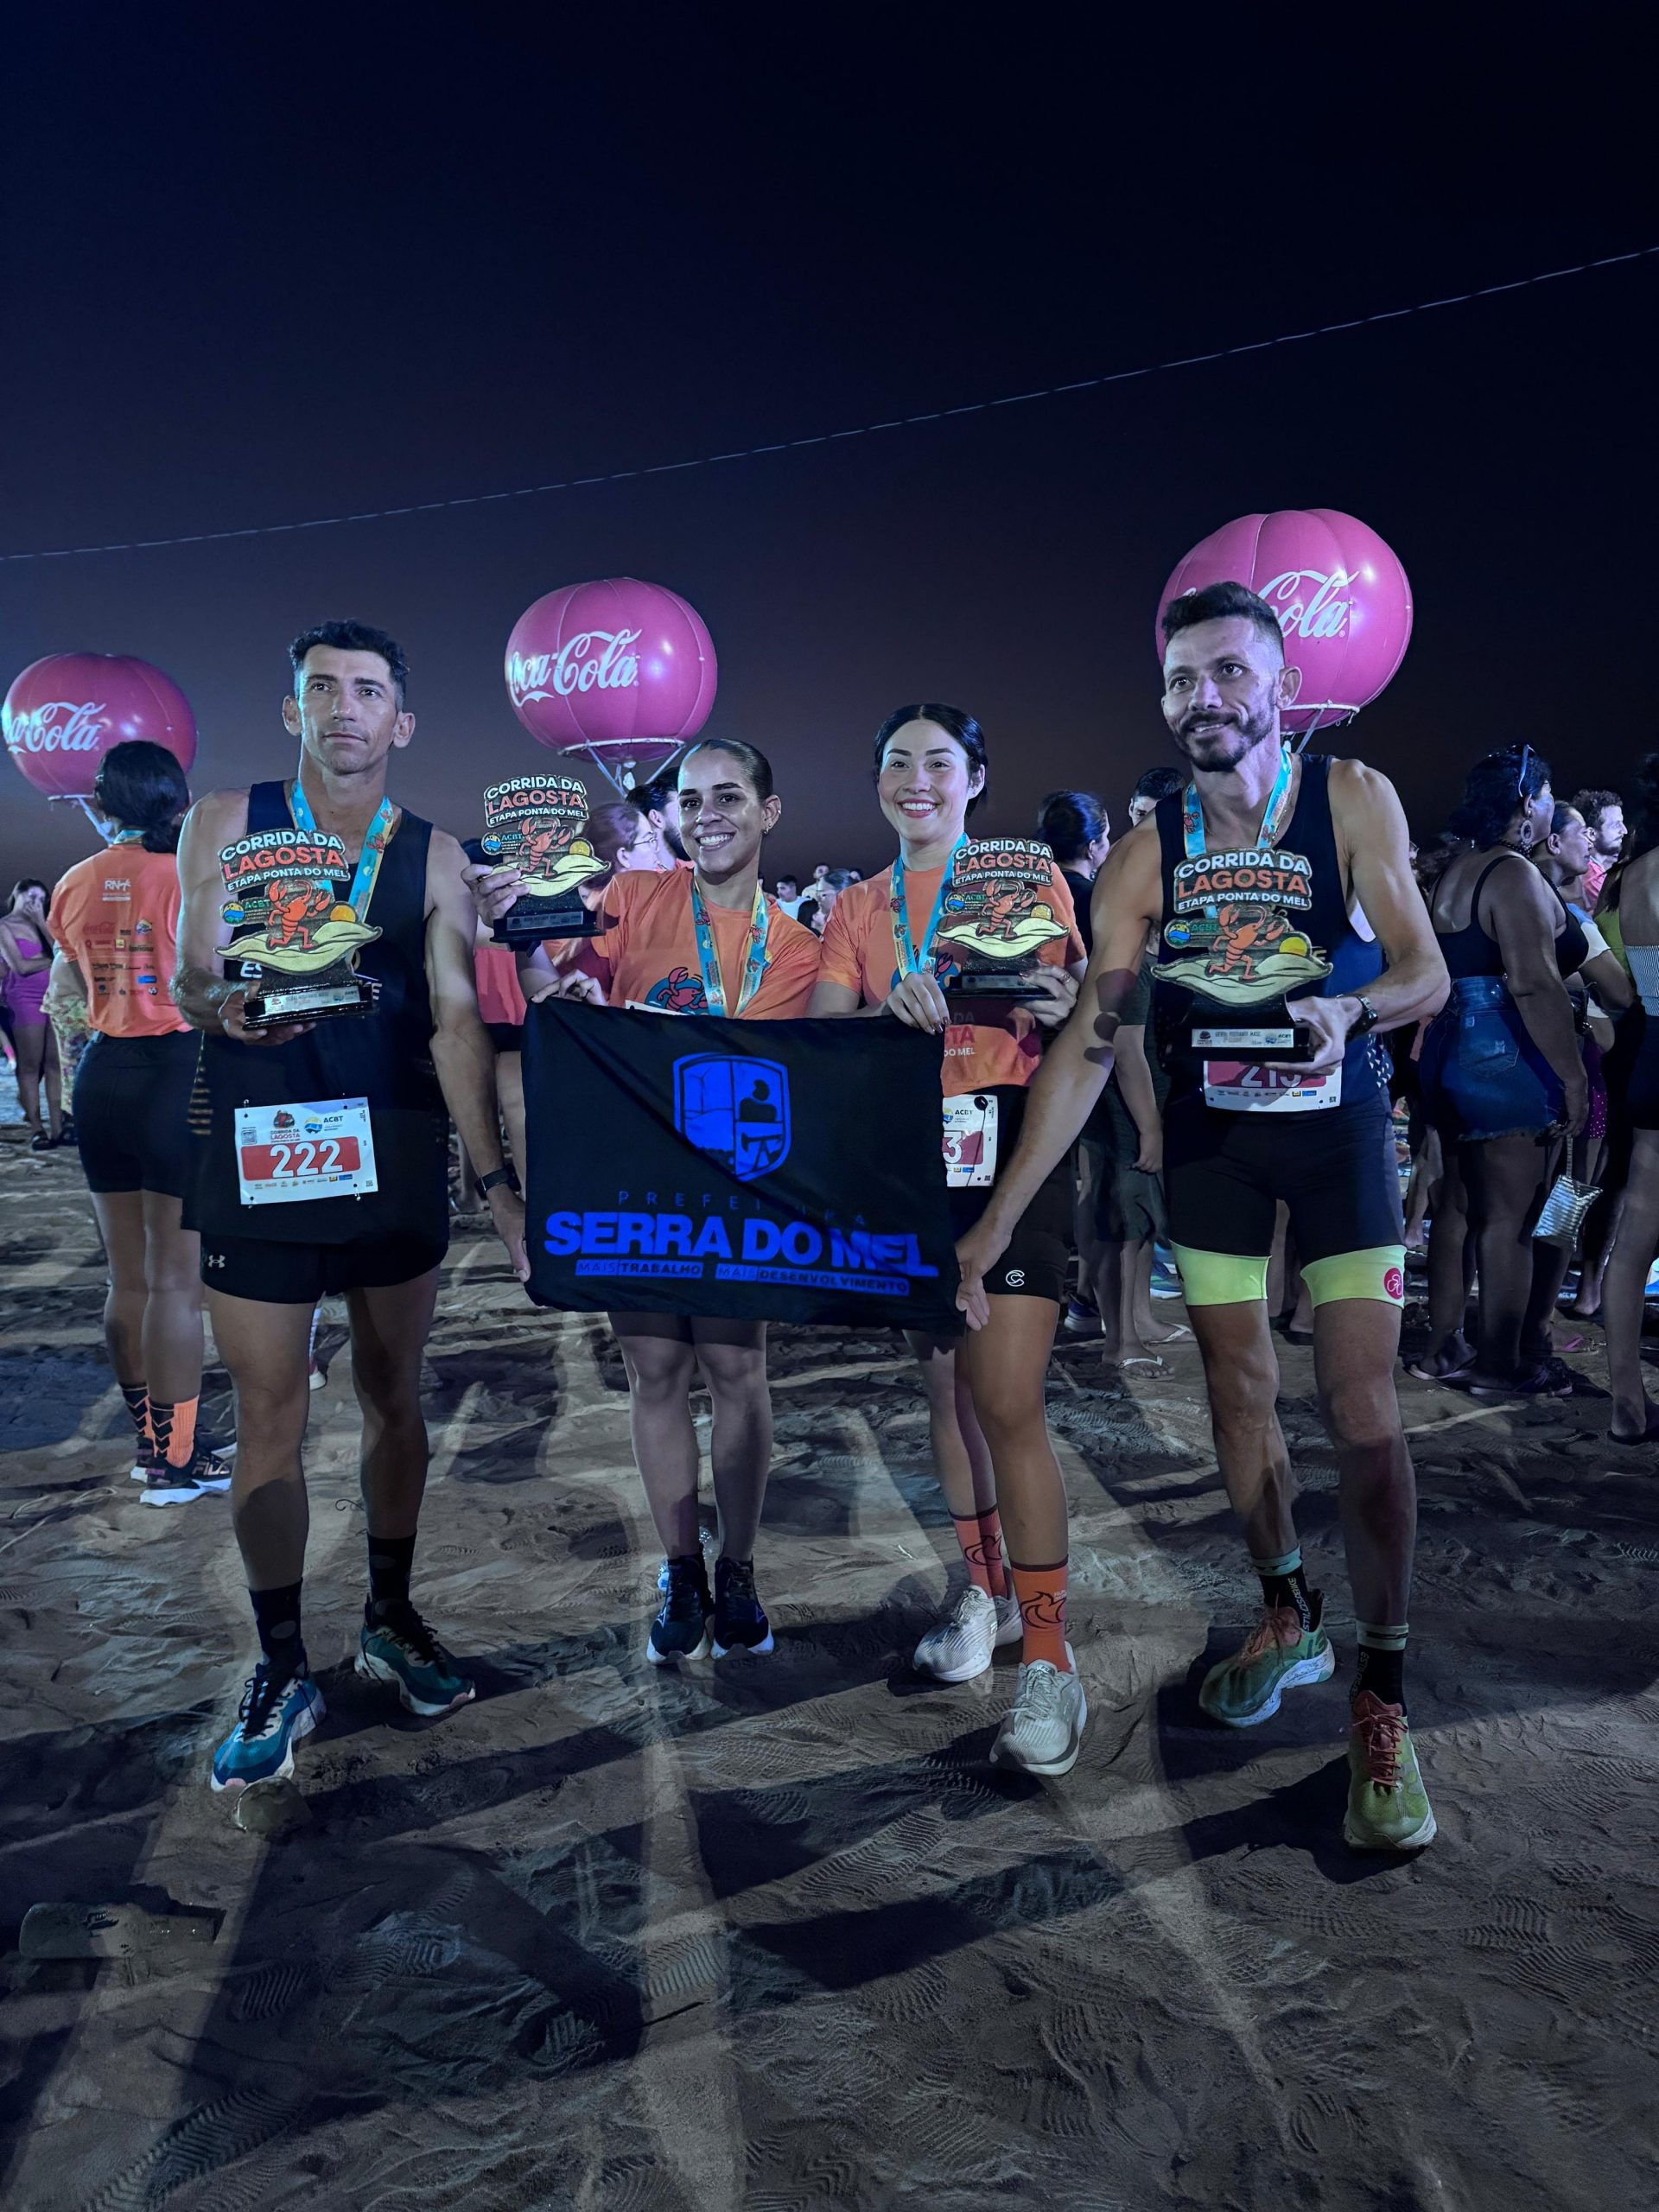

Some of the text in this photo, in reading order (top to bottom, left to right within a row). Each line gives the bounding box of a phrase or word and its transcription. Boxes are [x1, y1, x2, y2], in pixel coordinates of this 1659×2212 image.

[486, 776, 584, 799] CORRIDA DA
[487, 790, 585, 815] LAGOSTA
[490, 810, 517, 824] ETAPA
[518, 808, 550, 818] PONTA
[567, 810, 586, 818] MEL
[221, 831, 342, 861] CORRIDA DA
[955, 840, 1052, 860] CORRIDA DA
[223, 846, 345, 880] LAGOSTA
[955, 853, 1051, 875] LAGOSTA
[1178, 852, 1309, 879] CORRIDA DA
[227, 868, 347, 891] ETAPA PONTA DO MEL
[956, 872, 983, 885] ETAPA
[984, 870, 1015, 880] PONTA
[1033, 874, 1051, 883] MEL
[1178, 868, 1307, 899] LAGOSTA
[1178, 892, 1308, 911] ETAPA PONTA DO MEL
[270, 1139, 343, 1179] 222
[544, 1211, 940, 1278] SERRA DO MEL
[620, 1262, 701, 1275] TRABALHO
[760, 1268, 909, 1294] DESENVOLVIMENTO
